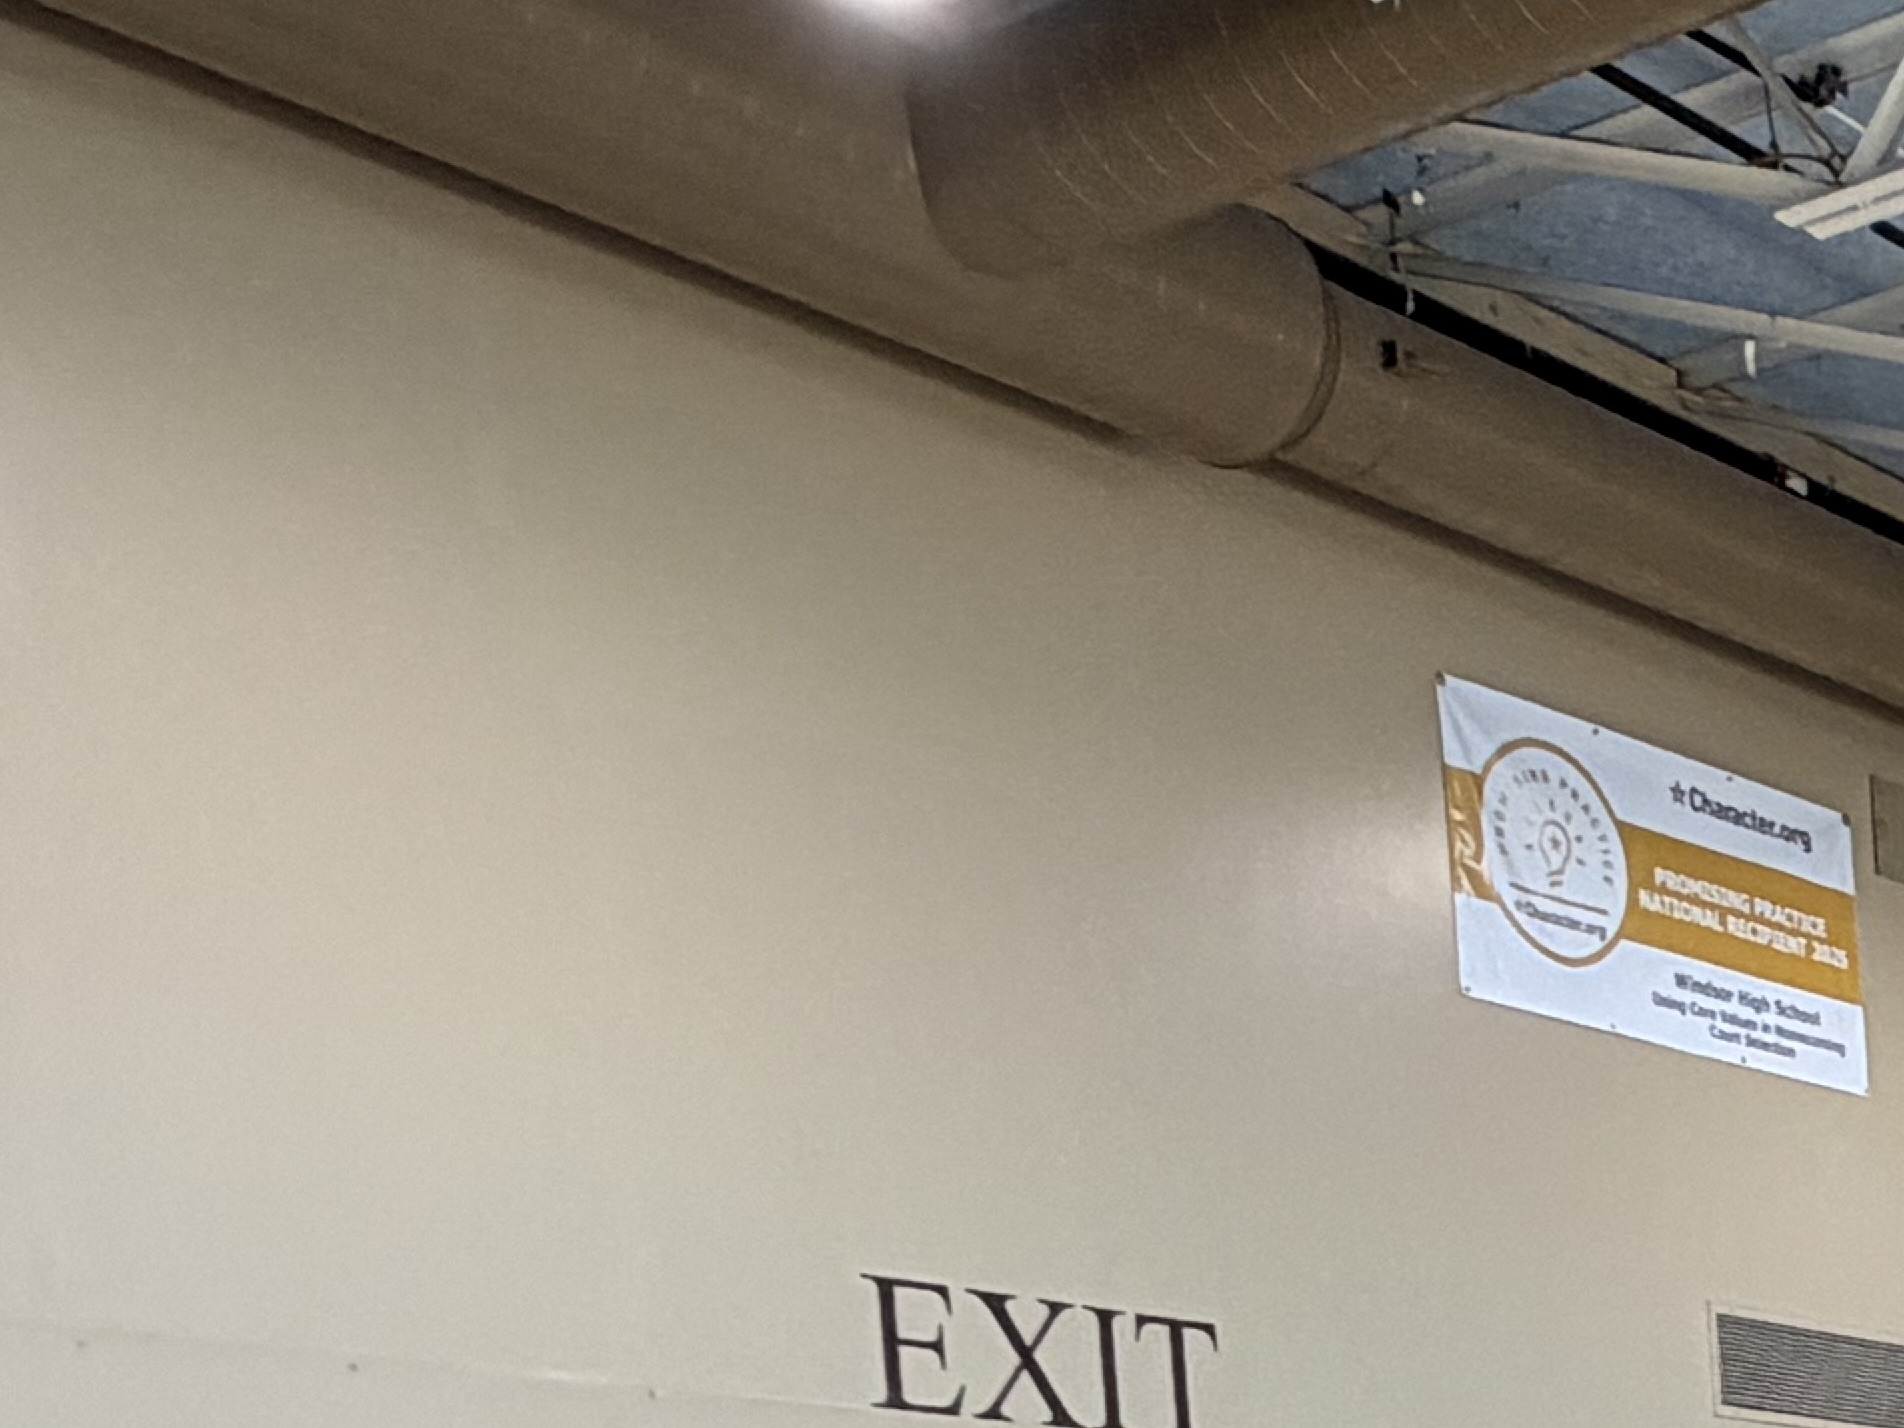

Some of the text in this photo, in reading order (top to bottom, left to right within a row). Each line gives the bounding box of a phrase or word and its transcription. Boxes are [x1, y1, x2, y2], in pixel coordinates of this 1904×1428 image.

[1689, 786, 1813, 854] Character.org
[1638, 888, 1725, 933] NATIONAL
[1726, 914, 1807, 958] RECIPIENT
[1654, 866, 1827, 938] PROMISING PRACTICE
[1674, 972, 1821, 1026] Windsor High School
